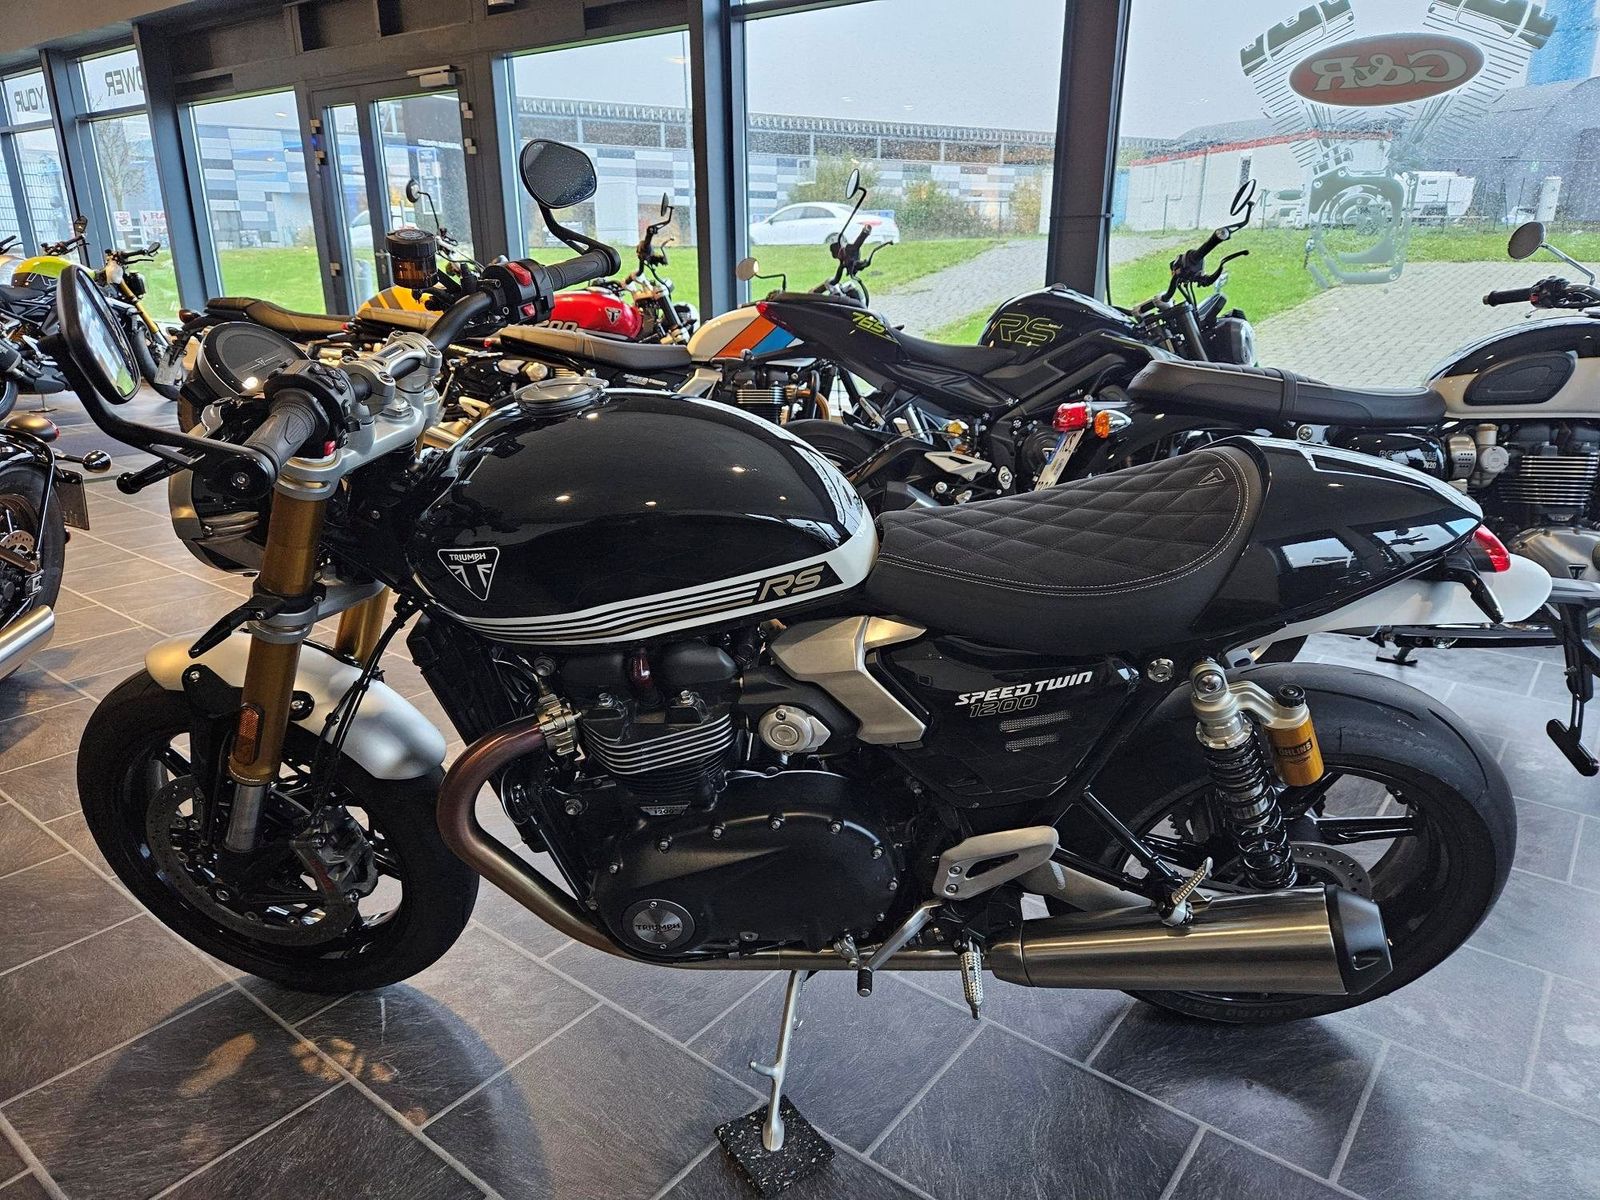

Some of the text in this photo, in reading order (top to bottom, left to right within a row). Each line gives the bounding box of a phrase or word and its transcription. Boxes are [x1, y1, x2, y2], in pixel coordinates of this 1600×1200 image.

[987, 313, 1056, 347] RS
[449, 552, 486, 564] TRIUMPH
[758, 565, 825, 602] RS
[955, 671, 1093, 706] SPEED TWIN
[969, 694, 1040, 718] 1200
[635, 923, 680, 932] TRIUMPH
